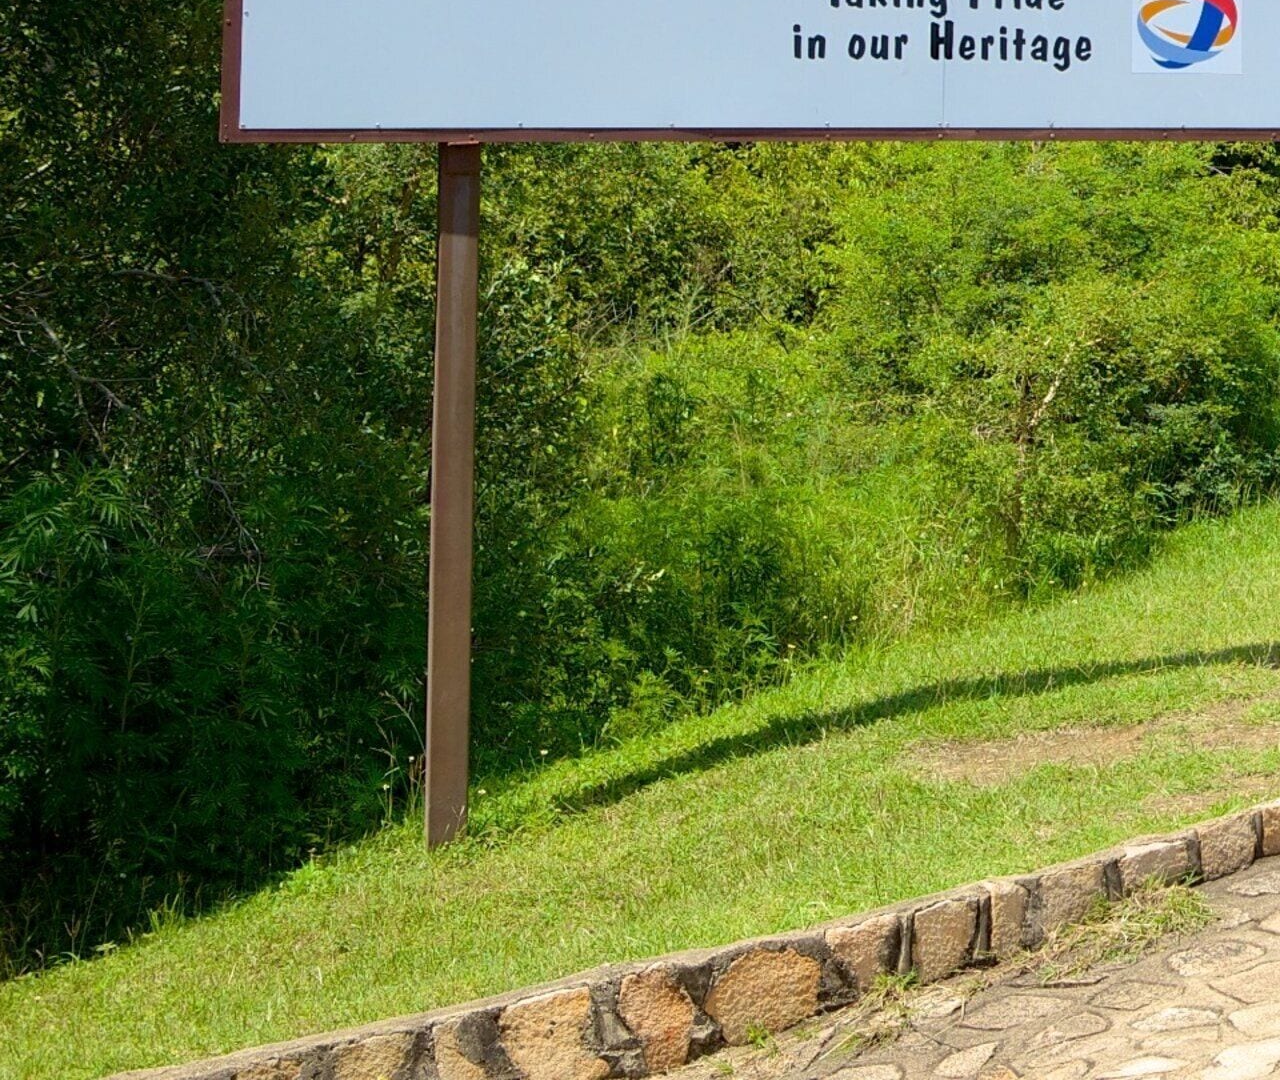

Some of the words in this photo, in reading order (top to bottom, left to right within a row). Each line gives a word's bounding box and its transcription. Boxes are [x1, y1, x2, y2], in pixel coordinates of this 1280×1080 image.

[792, 23, 826, 60] in
[847, 33, 909, 61] our
[930, 19, 1092, 72] Heritage
